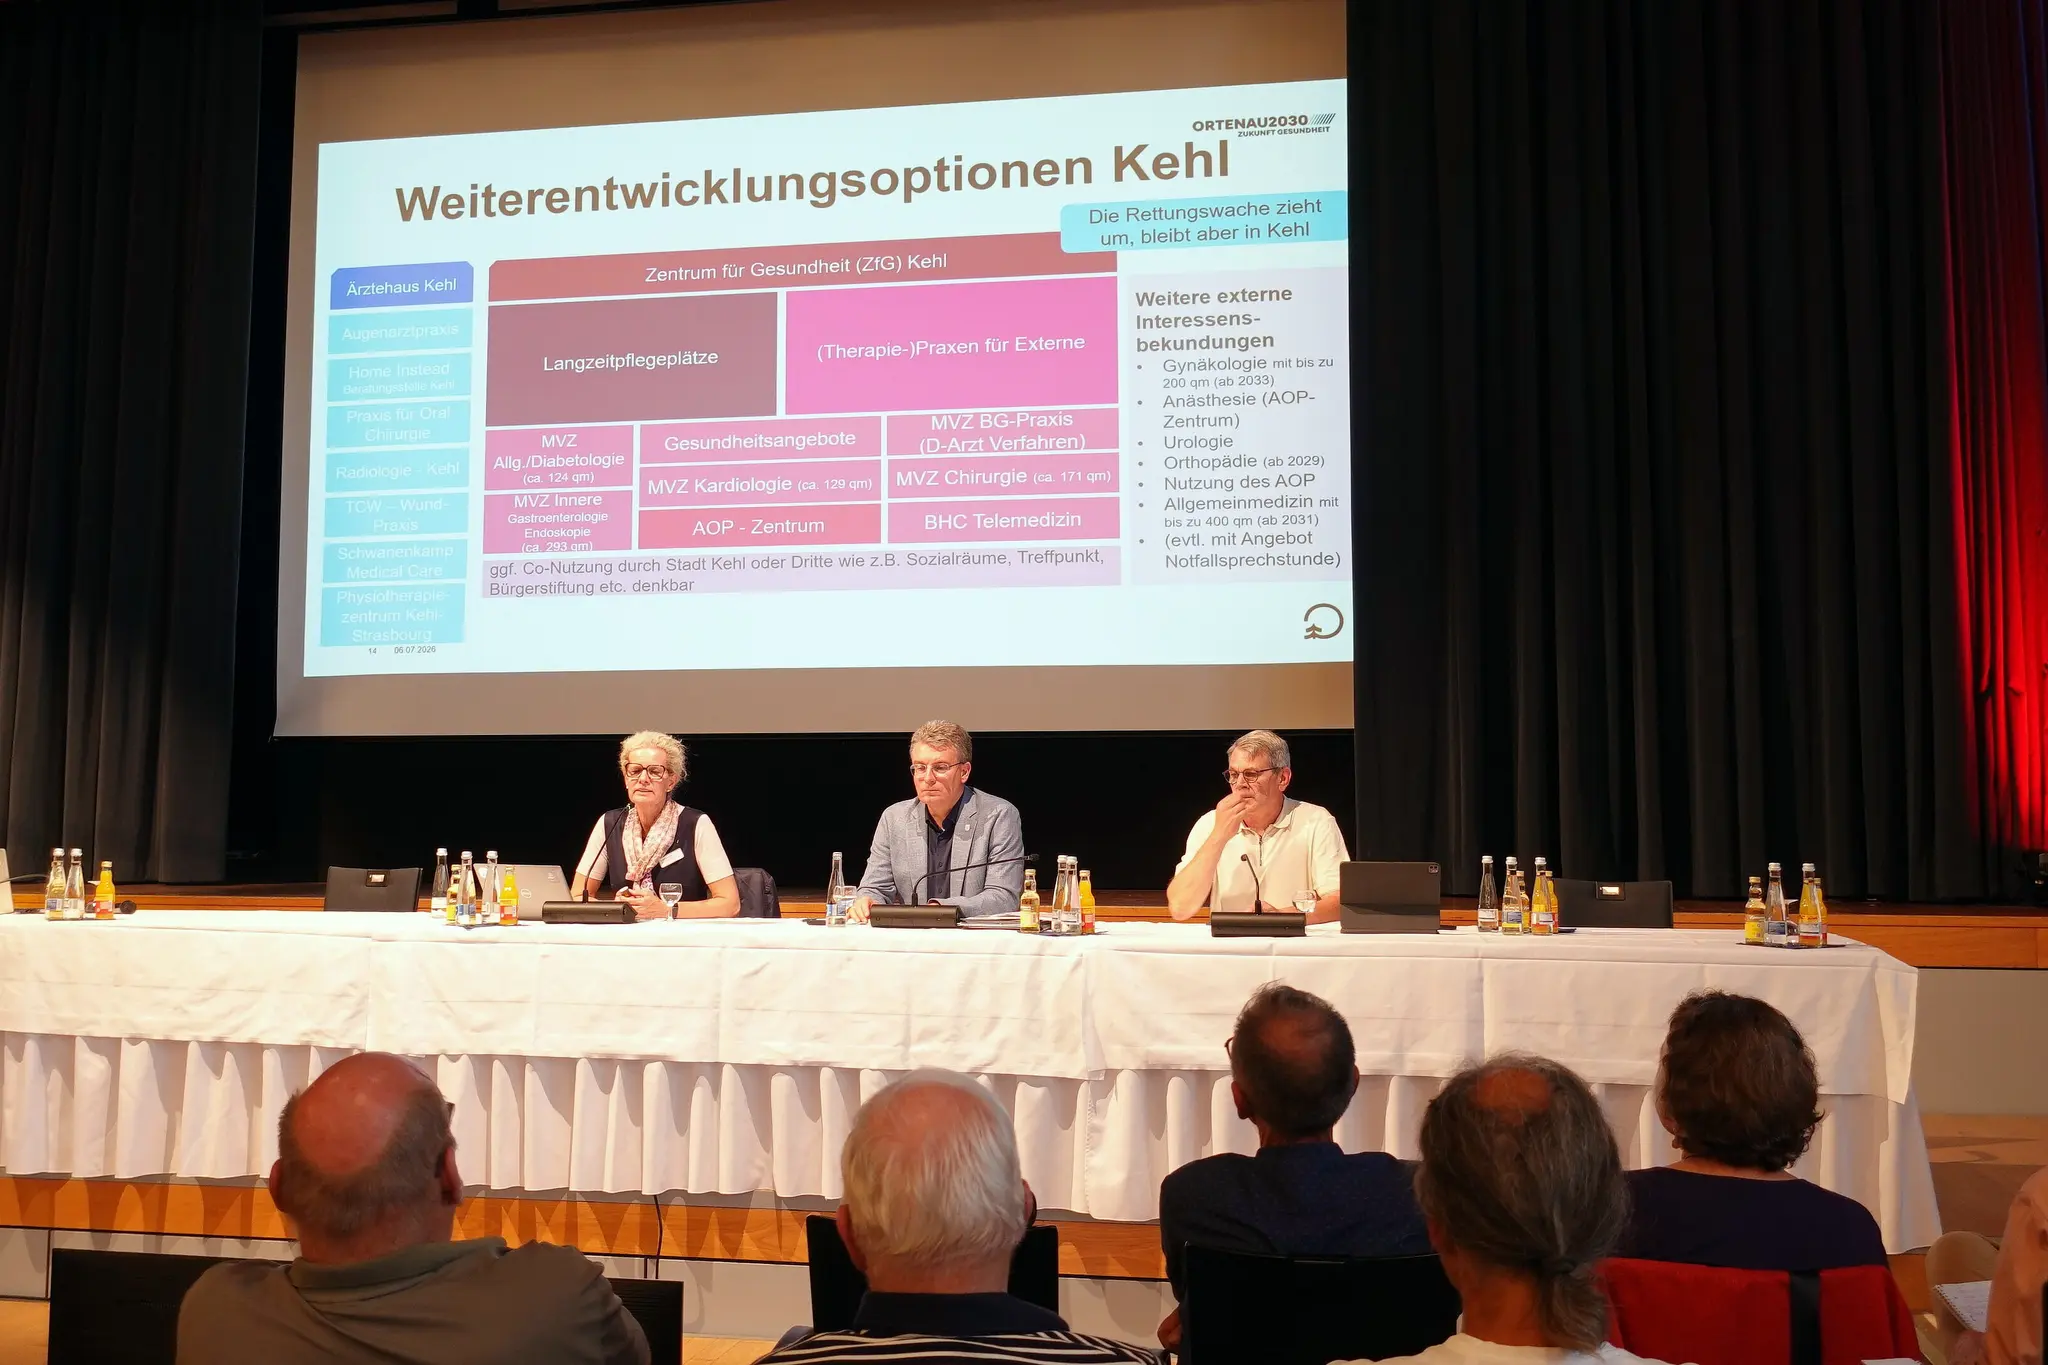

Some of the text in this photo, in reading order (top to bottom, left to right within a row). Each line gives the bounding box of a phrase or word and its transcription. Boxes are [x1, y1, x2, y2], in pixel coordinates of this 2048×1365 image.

[1192, 115, 1308, 132] ORTENAU2030
[1238, 126, 1330, 137] ZUKUNFT GESUNDHEIT
[395, 140, 1229, 222] Weiterentwicklungsoptionen Kehl
[1089, 199, 1323, 224] Die Rettungswache zieht
[1100, 221, 1310, 249] um, bleibt aber in Kehl
[645, 254, 947, 283] Zentrum für Gesundheit (ZfG) Kehl
[347, 278, 457, 296] Ärztehaus Kehl
[1136, 288, 1293, 307] Weitere externe
[1136, 312, 1261, 329] Interessens-
[342, 324, 459, 342] Augenarztpraxis
[816, 333, 1086, 362] (Therapie-)Praxen für Externe
[1136, 335, 1274, 352] bekundungen
[543, 349, 719, 373] Langzeitpflegeplätze
[1162, 356, 1334, 375] Gynäkologie mit bis zu
[349, 363, 450, 379] Home Instead
[343, 380, 455, 395] Beratungsstelle Kehl
[1162, 374, 1275, 389] 200 qm (ab 2033)
[1163, 390, 1316, 408] Anästhesie (AOP-
[347, 406, 450, 423] Praxis für Oral
[931, 410, 1074, 431] MVZ BG-Praxis
[1163, 413, 1240, 430] Zentrum)
[365, 428, 431, 443] Chirurgie
[541, 433, 578, 448] MVZ
[664, 432, 856, 451] Gesundheitsangebote
[919, 433, 1086, 455] (D-Arzt Verfahren)
[1164, 434, 1234, 451] Urologie
[336, 464, 412, 480] Radiologie
[428, 461, 460, 476] Kehl
[493, 453, 625, 472] Allg./Diabetologie
[1164, 454, 1325, 471] Orthopädie (ab 2029)
[523, 471, 595, 486] (ca. 124 qm)
[647, 476, 873, 495] MVZ Kardiologie (ca. 129 qm)
[896, 467, 1111, 487] MVZ Chirurgie (ca. 171 qm)
[1164, 473, 1316, 492] Nutzung des AOP
[346, 500, 383, 514] TCW
[400, 498, 449, 512] Wund-
[514, 493, 603, 508] MVZ Innere
[1164, 495, 1339, 513] Allgemeinmedizin mit
[374, 518, 419, 532] Praxis
[507, 511, 608, 525] Gastroenterologie
[924, 512, 1082, 530] BHC Telemedizin
[1164, 513, 1319, 528] bis zu 400 qm (ab 2031)
[524, 526, 591, 539] Endoskopie
[692, 521, 735, 536] AOP
[751, 519, 825, 535] Zentrum
[521, 541, 541, 554] (ca.
[546, 541, 567, 552] 293
[1165, 531, 1313, 550] (evtl. mit Angebot
[337, 545, 454, 561] Schwanenkamp
[1165, 551, 1341, 570] Notfallsprechstunde)
[347, 564, 443, 579] Medical Care
[490, 548, 1104, 578] ggf. Co-Nutzung durch Stadt Kehl oder Dritte wie z.B. Sozialräume, Treffpunkt,
[490, 578, 695, 598] Bürgerstiftung etc. denkbar
[337, 590, 449, 606] Physiotherapie-
[341, 608, 443, 624] zentrum Kehl-
[352, 627, 433, 643] Strasbourg
[394, 646, 436, 654] 06.07.2026
